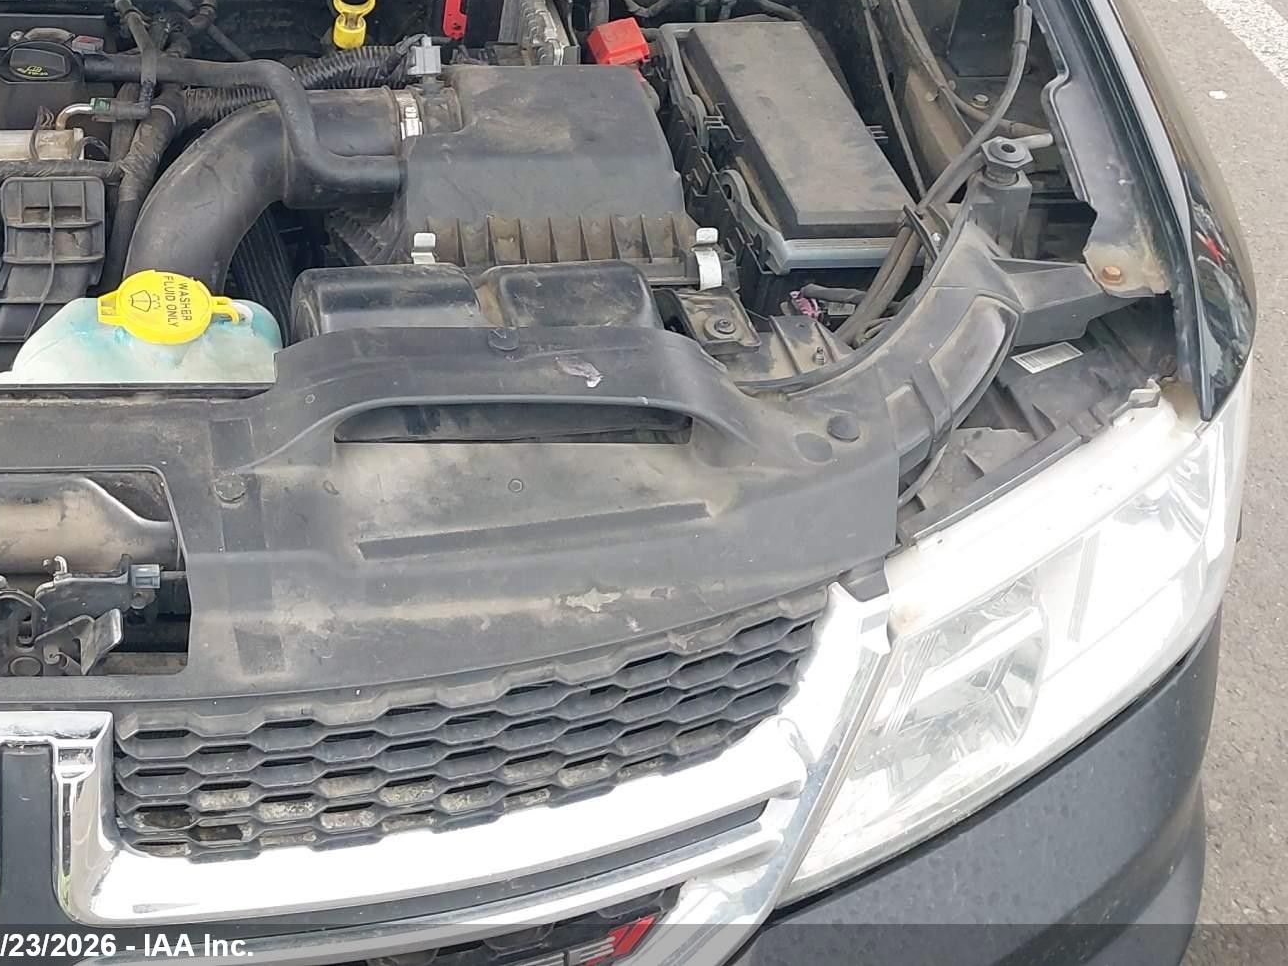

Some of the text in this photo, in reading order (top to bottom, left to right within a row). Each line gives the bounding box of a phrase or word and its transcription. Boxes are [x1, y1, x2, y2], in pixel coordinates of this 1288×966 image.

[163, 275, 179, 327] FLUID ONLY
[178, 282, 193, 321] WASHER
